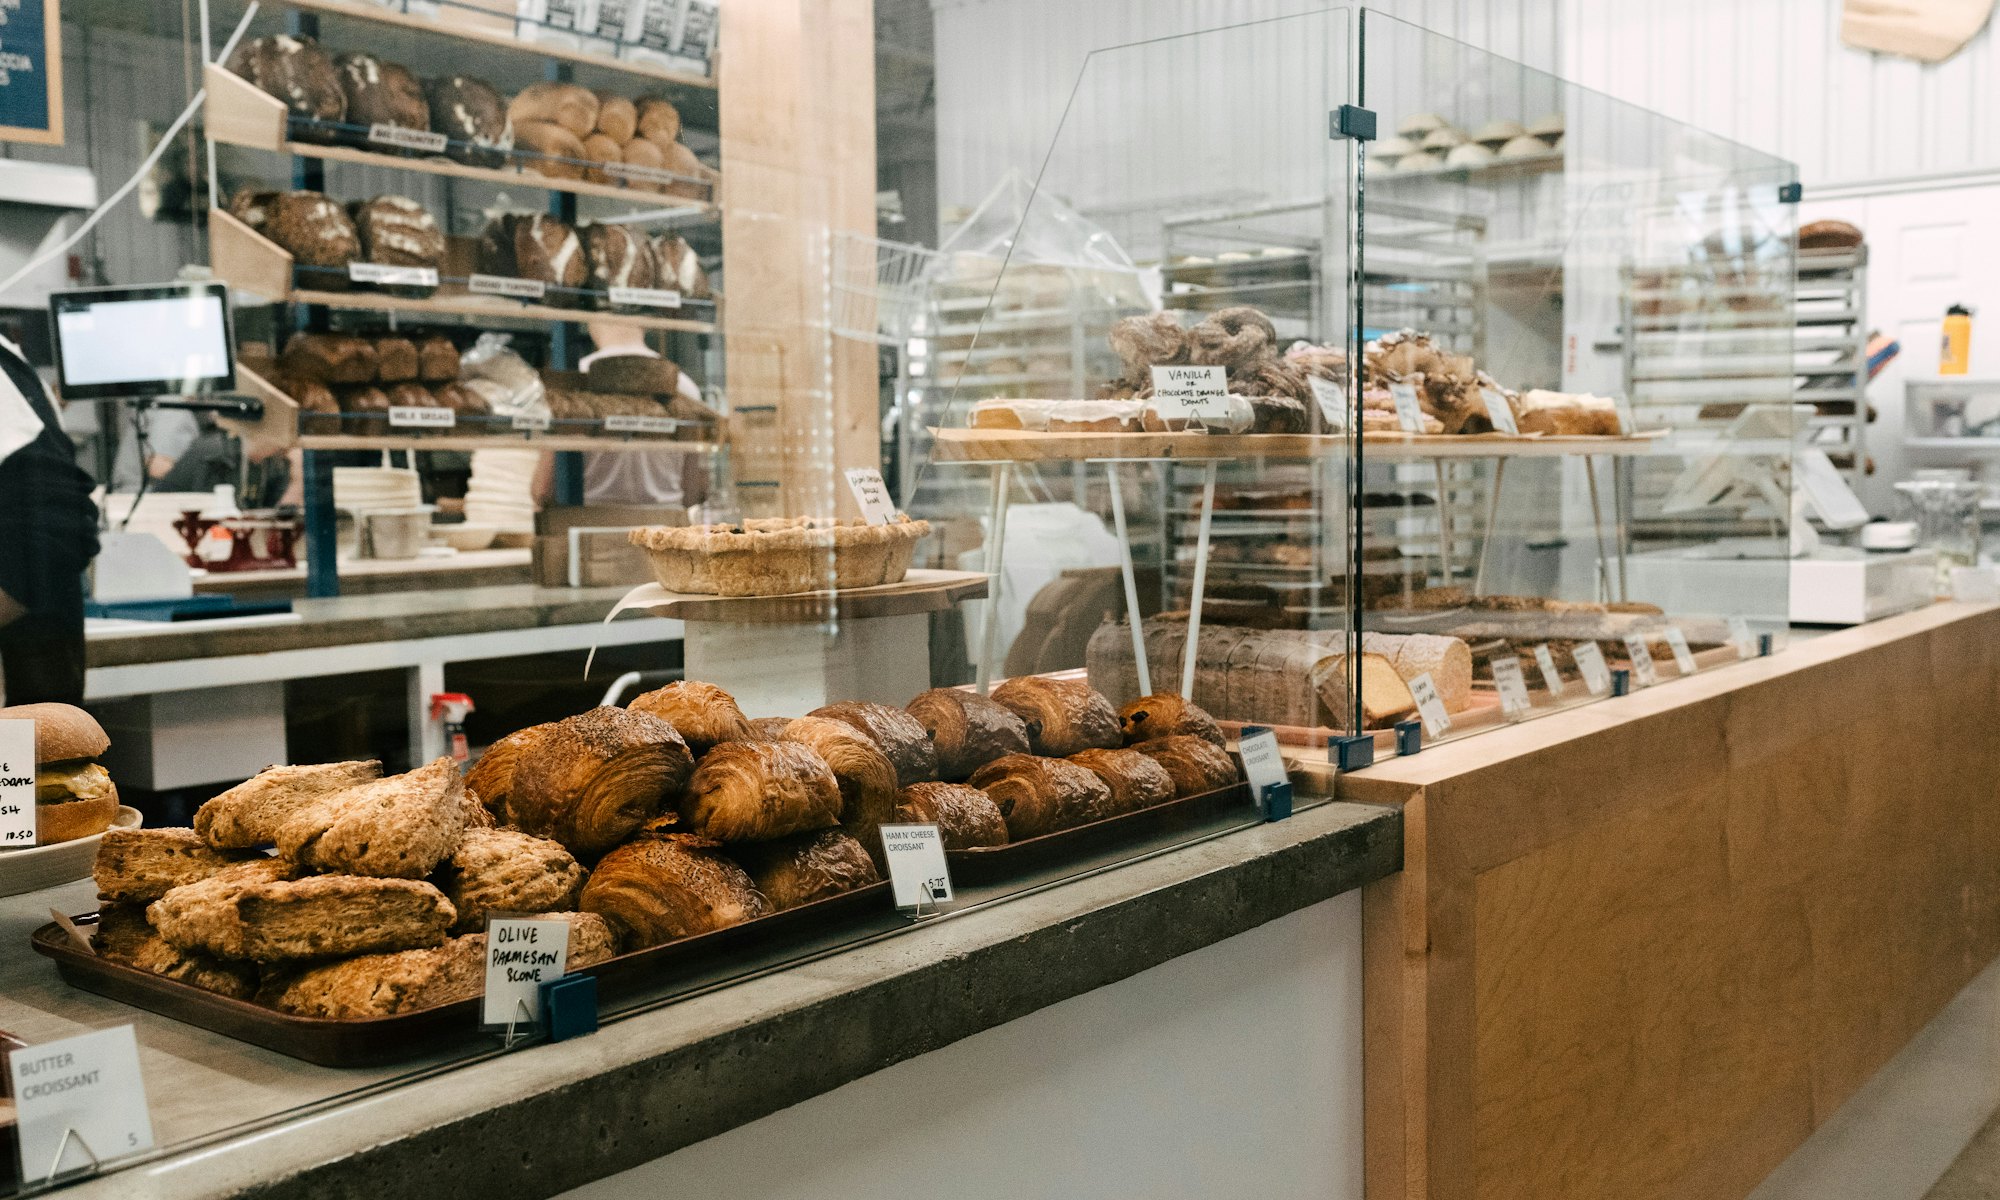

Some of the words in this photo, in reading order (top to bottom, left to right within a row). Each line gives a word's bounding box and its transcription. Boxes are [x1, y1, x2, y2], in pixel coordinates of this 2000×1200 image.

[1168, 369, 1212, 380] VANILLA
[1157, 388, 1194, 397] CHOCOLATE
[1180, 398, 1210, 406] DONUTS
[1242, 741, 1268, 754] CHOCOLATE
[1246, 752, 1270, 766] CROISSANT
[0, 777, 34, 787] DDAR
[885, 832, 902, 840] HAM
[910, 830, 935, 839] CHEESE
[888, 843, 925, 852] CROISSANT
[928, 877, 945, 889] 5.75
[498, 926, 538, 944] OLIVE
[492, 948, 559, 968] PARMESAN
[506, 967, 542, 983] SCONE
[20, 1052, 75, 1077] BUTTER
[22, 1069, 100, 1100] CROISSANT
[127, 1132, 138, 1147] 5
